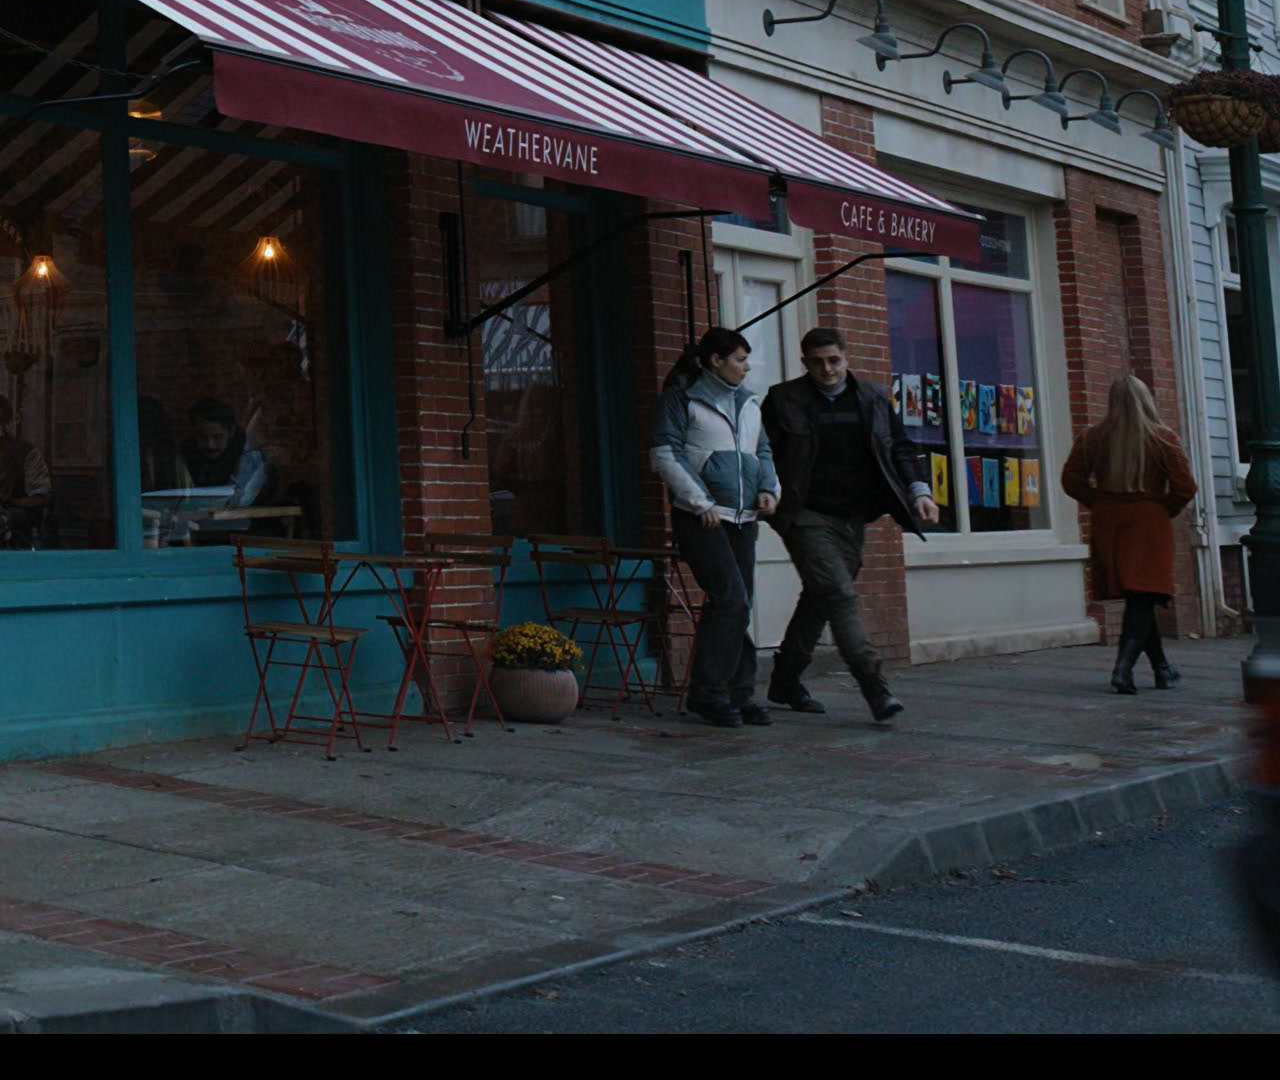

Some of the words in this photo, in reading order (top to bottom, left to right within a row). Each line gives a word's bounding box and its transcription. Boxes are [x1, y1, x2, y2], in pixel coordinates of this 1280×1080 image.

[464, 119, 599, 174] WEATHERVANE
[840, 201, 873, 231] CAFE
[877, 210, 886, 234] &
[890, 213, 937, 244] BAKERY
